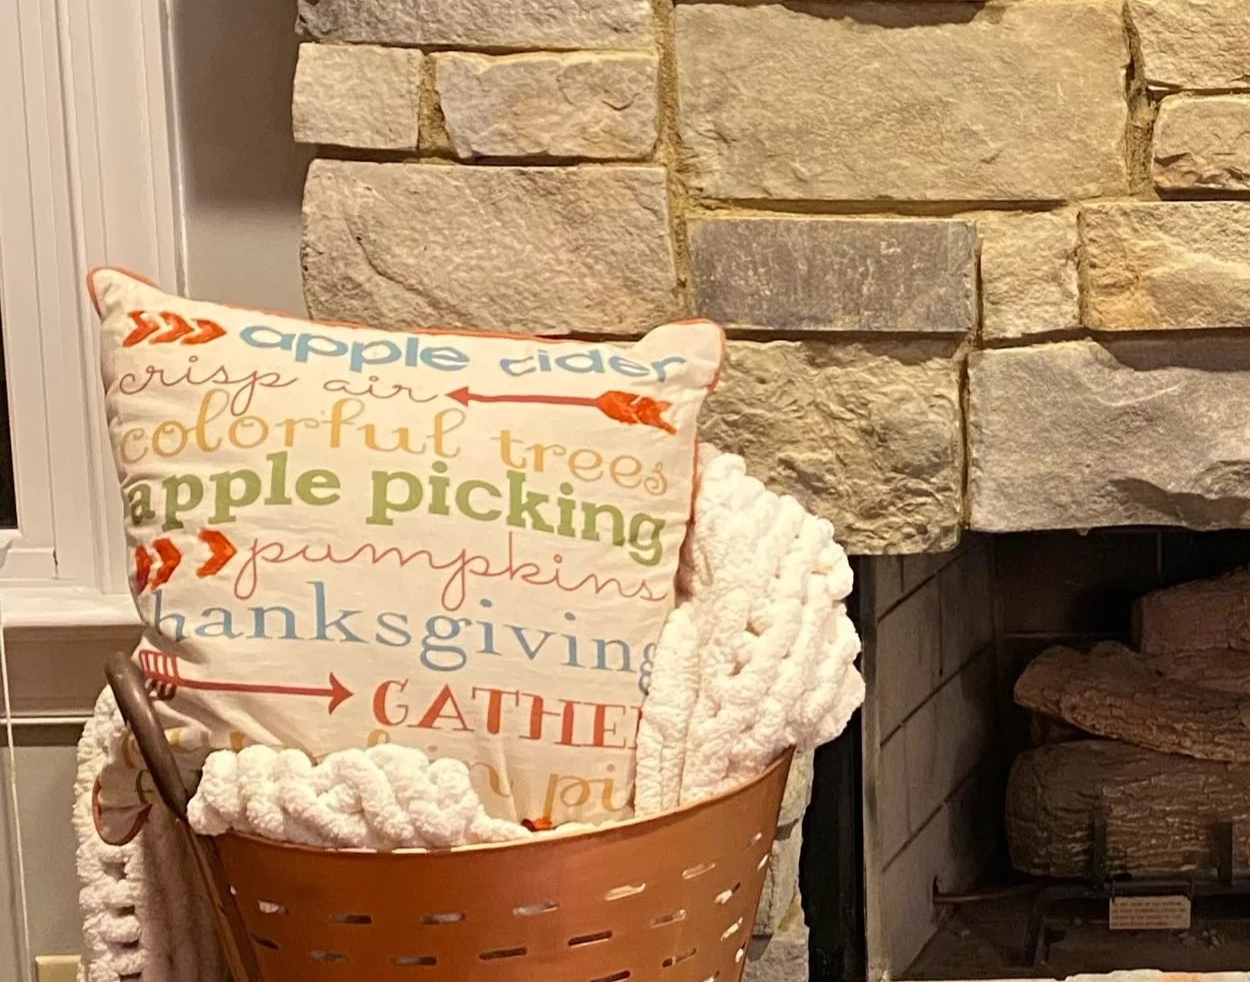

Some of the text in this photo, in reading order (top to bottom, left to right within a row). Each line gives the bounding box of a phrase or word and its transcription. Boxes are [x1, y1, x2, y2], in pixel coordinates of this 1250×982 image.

[119, 355, 438, 417] crisp air
[239, 323, 687, 382] apple cider
[119, 388, 669, 497] colorful trees
[126, 452, 668, 566] apple picking
[234, 531, 669, 613] pumpkins
[371, 678, 642, 750] GATHE
